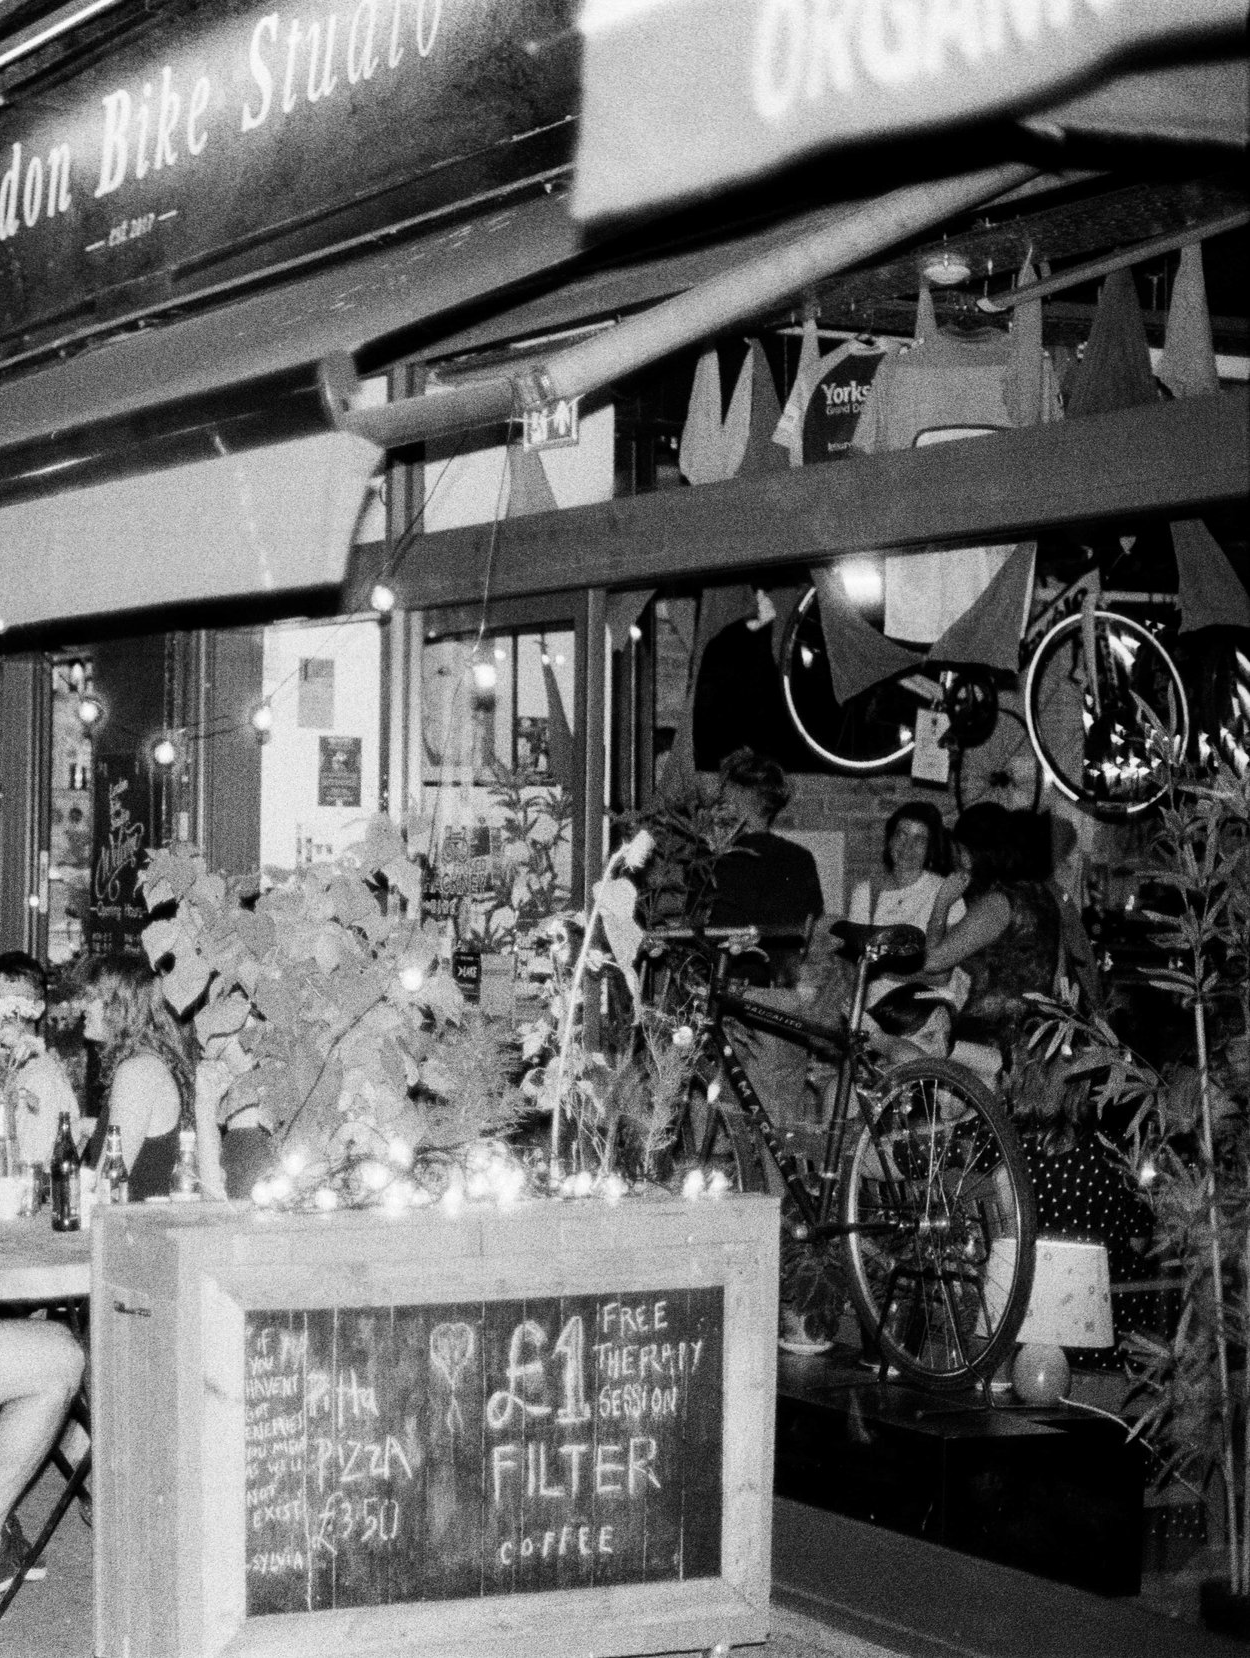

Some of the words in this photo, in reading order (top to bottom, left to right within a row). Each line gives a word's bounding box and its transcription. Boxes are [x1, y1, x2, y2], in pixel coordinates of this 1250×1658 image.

[94, 65, 211, 197] Bike
[602, 1300, 668, 1336] FREE
[486, 1315, 591, 1429] £1
[593, 1339, 703, 1378] THERAPY
[599, 1382, 678, 1419] SESSION
[313, 1434, 413, 1493] PIZZA
[491, 1437, 662, 1506] FILTER
[500, 1525, 613, 1565] COFFEE
